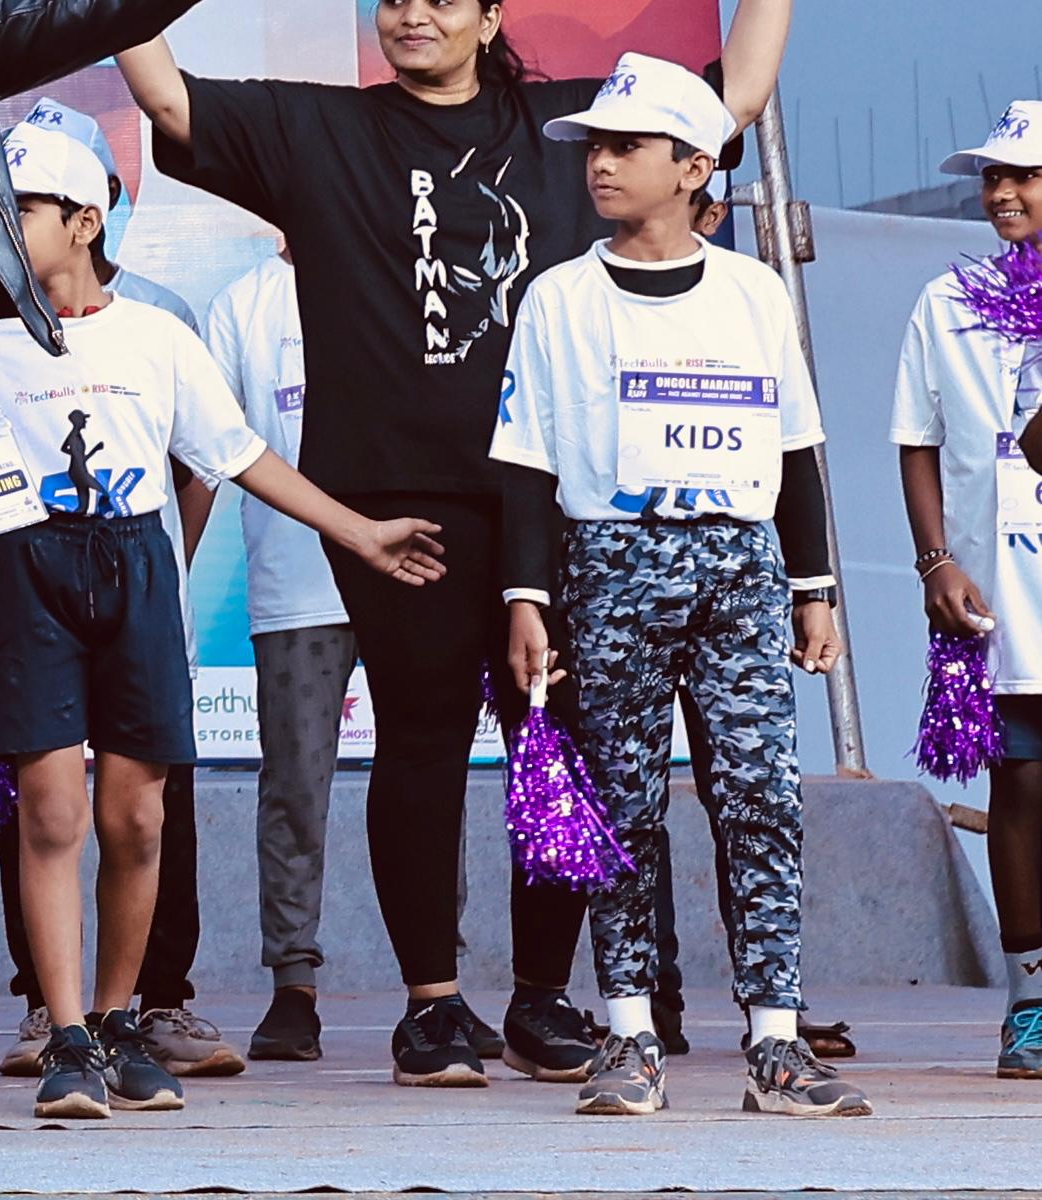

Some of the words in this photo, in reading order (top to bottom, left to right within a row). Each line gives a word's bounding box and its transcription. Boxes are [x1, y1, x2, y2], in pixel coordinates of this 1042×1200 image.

[411, 169, 450, 350] BATMAN
[29, 387, 76, 403] TechBulls
[655, 376, 698, 390] ONGOLE
[700, 378, 753, 392] MARATHON
[664, 423, 743, 452] KIDS
[39, 467, 147, 517] 5K
